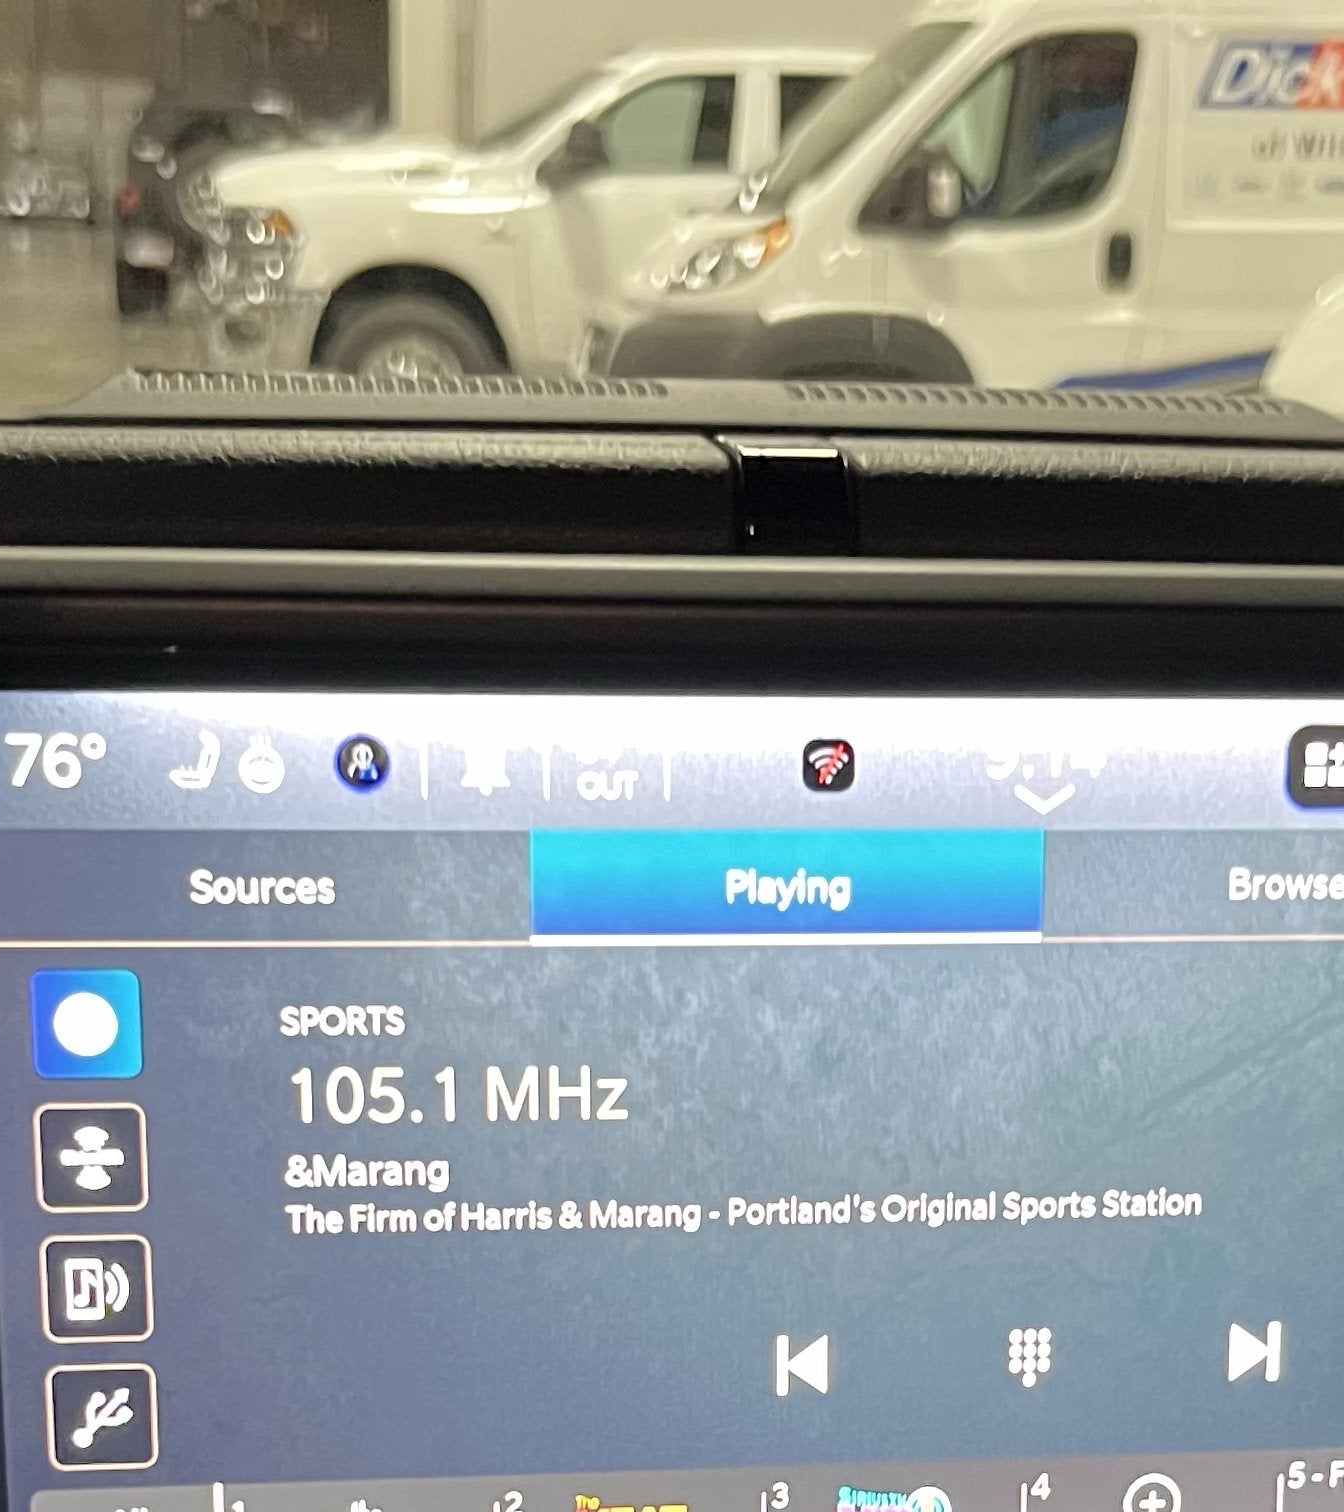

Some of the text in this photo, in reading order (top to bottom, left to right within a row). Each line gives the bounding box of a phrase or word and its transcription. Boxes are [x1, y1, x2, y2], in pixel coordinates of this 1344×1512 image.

[4, 732, 107, 788] 76°
[577, 770, 639, 801] OUT
[189, 869, 335, 905] Sources
[725, 867, 852, 911] Playing
[279, 1005, 406, 1037] SPORTS
[290, 1064, 629, 1125] 105.1 MHz
[284, 1153, 451, 1193] &Marang
[284, 1204, 344, 1235] The
[350, 1204, 417, 1233] Firm
[423, 1201, 458, 1232] of
[461, 1201, 553, 1231] Harris
[558, 1201, 583, 1230] &
[589, 1199, 703, 1233] Marang
[728, 1194, 876, 1227] Portland's
[881, 1191, 996, 1228] Original
[1002, 1190, 1097, 1226] Sports
[1102, 1187, 1203, 1219] Station
[771, 1482, 790, 1509] 3
[1030, 1473, 1050, 1500] 4
